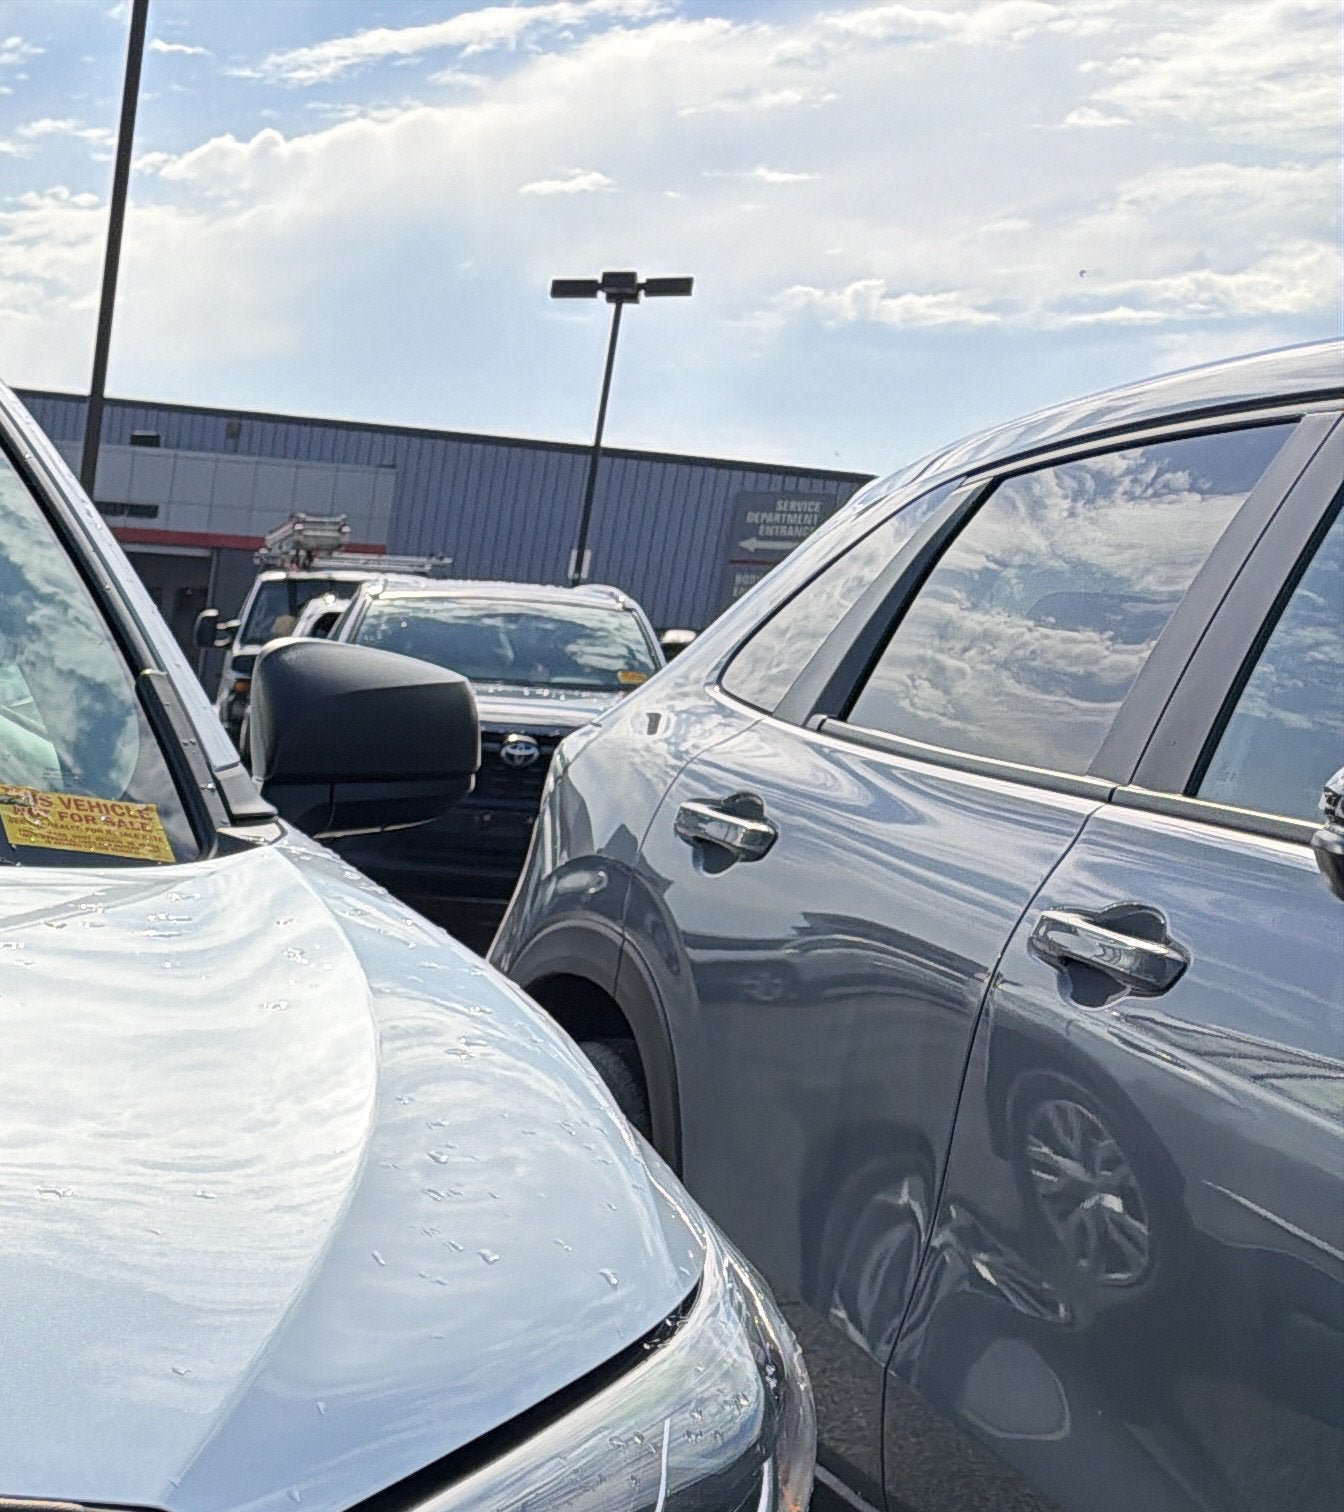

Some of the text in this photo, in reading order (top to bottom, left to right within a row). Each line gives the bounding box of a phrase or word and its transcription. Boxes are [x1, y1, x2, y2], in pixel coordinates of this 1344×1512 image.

[776, 500, 823, 512] SERVICE
[746, 511, 818, 525] DEPARTMENT
[57, 796, 154, 821] VEHICLE
[57, 811, 98, 825] FOR
[100, 816, 154, 833] SALE
